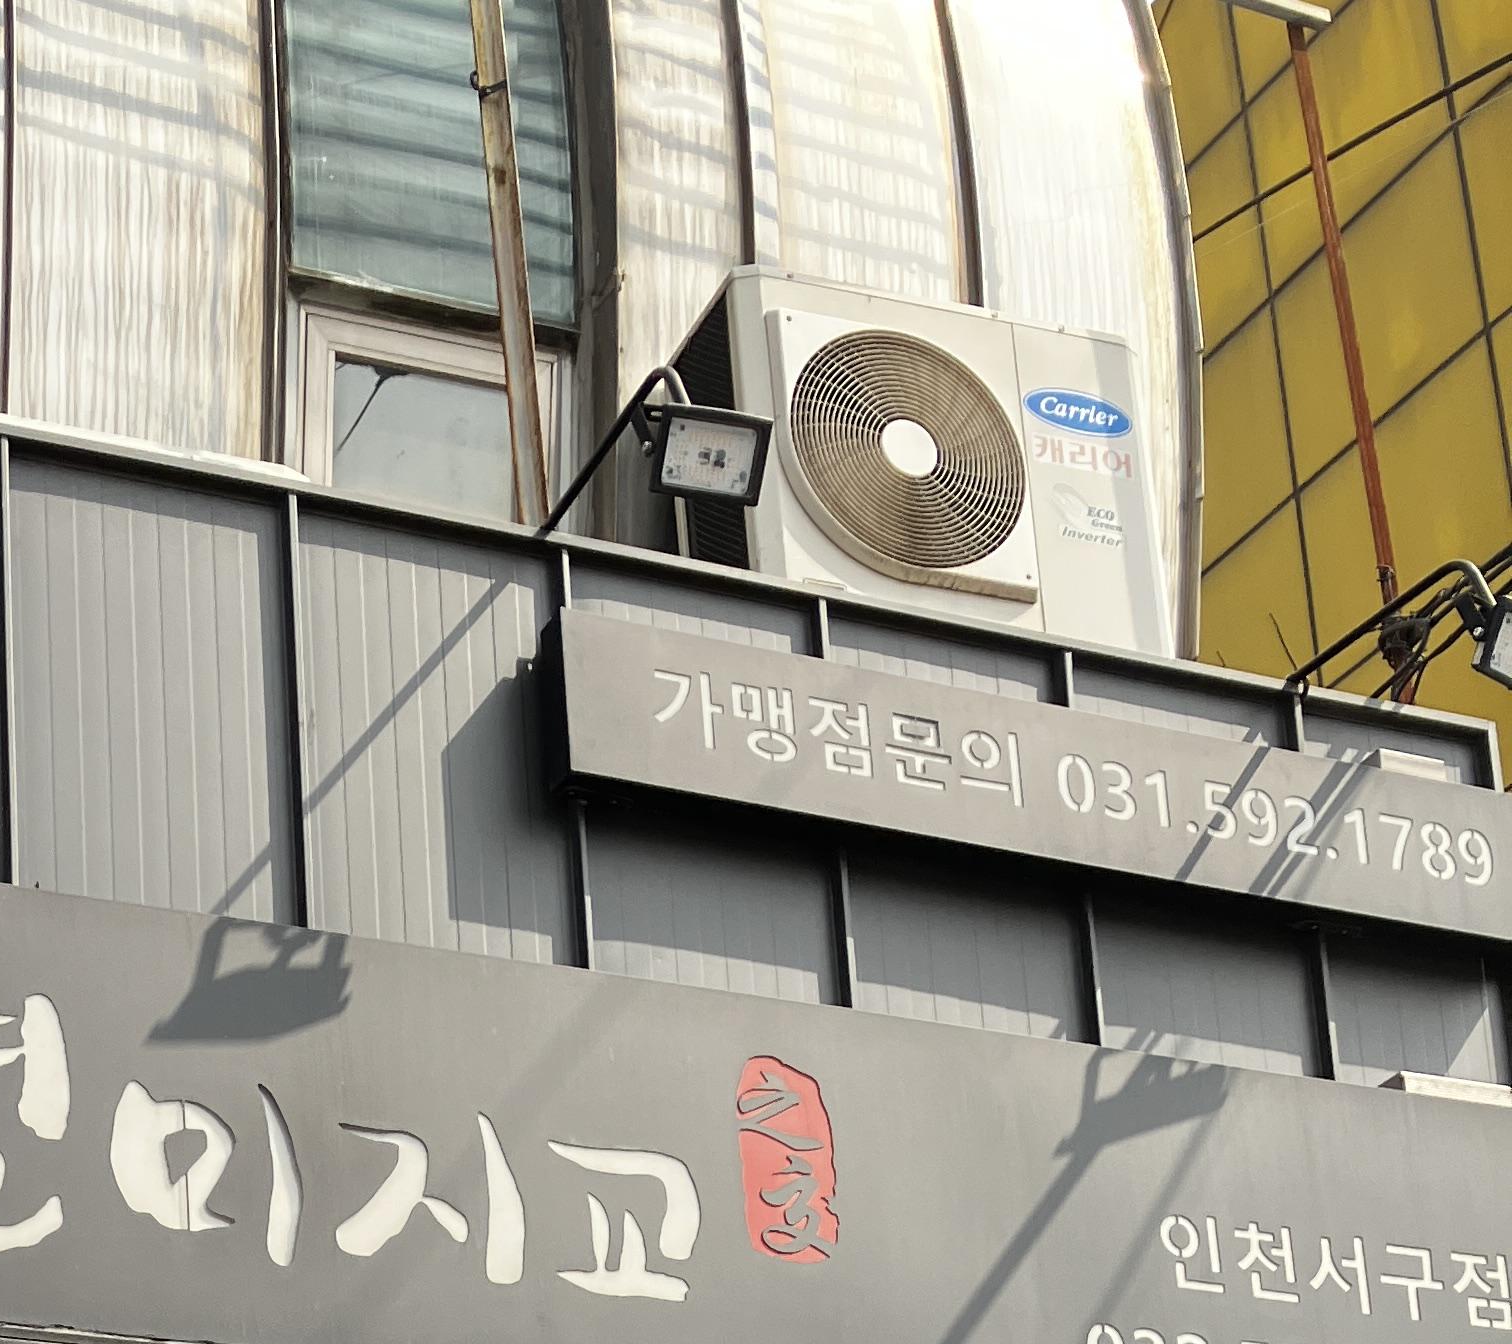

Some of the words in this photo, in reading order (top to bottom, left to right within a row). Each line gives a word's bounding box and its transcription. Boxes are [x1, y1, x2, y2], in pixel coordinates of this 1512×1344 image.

[1040, 396, 1119, 427] Carrier
[1034, 435, 1132, 478] 캐리어
[1086, 505, 1115, 522] ECO
[1061, 526, 1124, 547] Inverter
[653, 669, 1024, 807] 가맹점문의
[1057, 752, 1494, 888] 031.592.1789
[1160, 1214, 1512, 1330] 인천서구점
